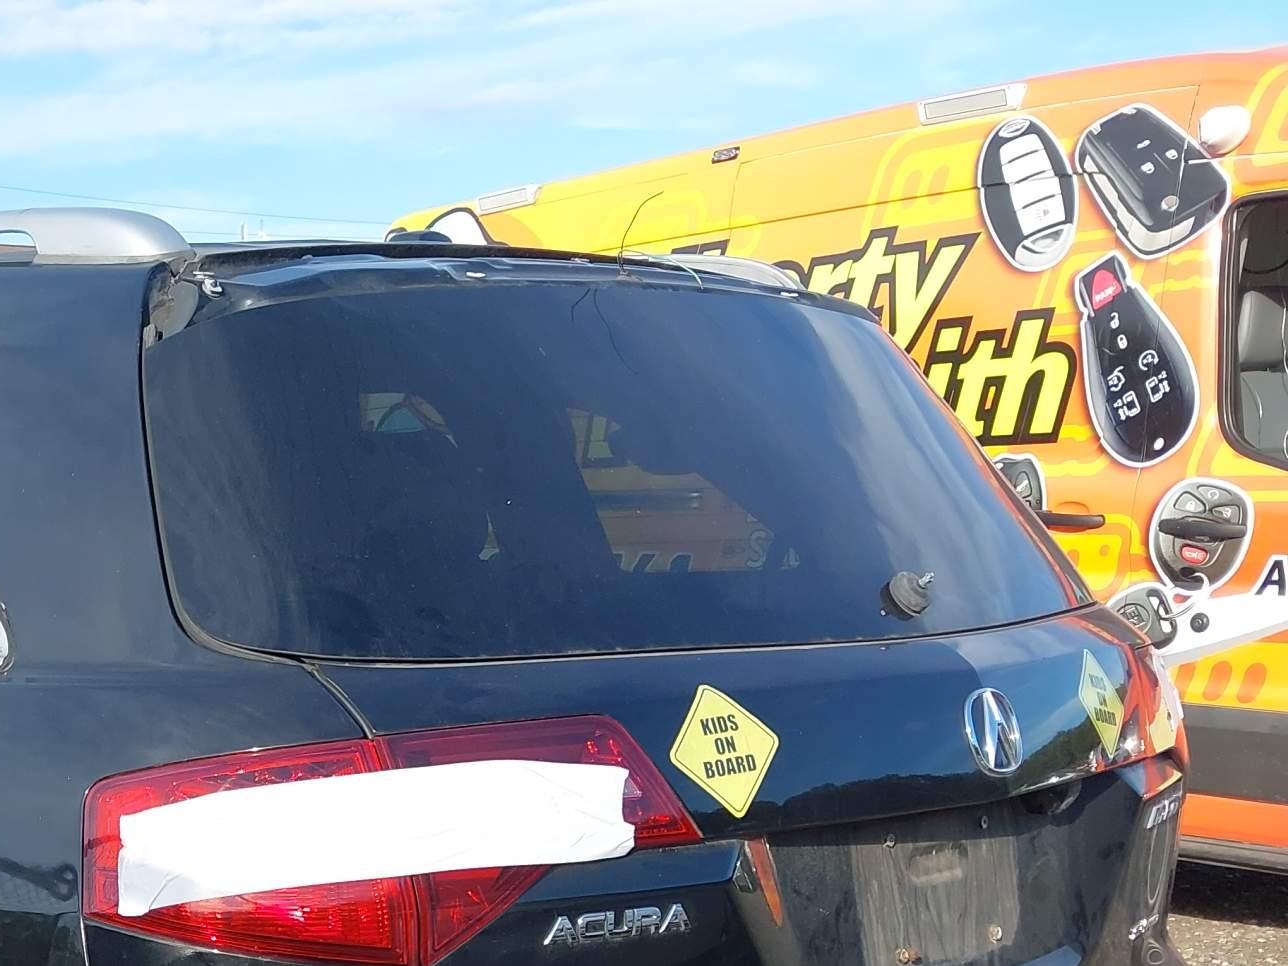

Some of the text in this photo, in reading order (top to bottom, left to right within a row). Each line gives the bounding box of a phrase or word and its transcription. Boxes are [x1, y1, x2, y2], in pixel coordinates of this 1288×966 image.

[700, 714, 739, 736] KIDS
[714, 735, 737, 755] ON
[703, 754, 757, 779] BOARD
[543, 903, 692, 946] ACURA
